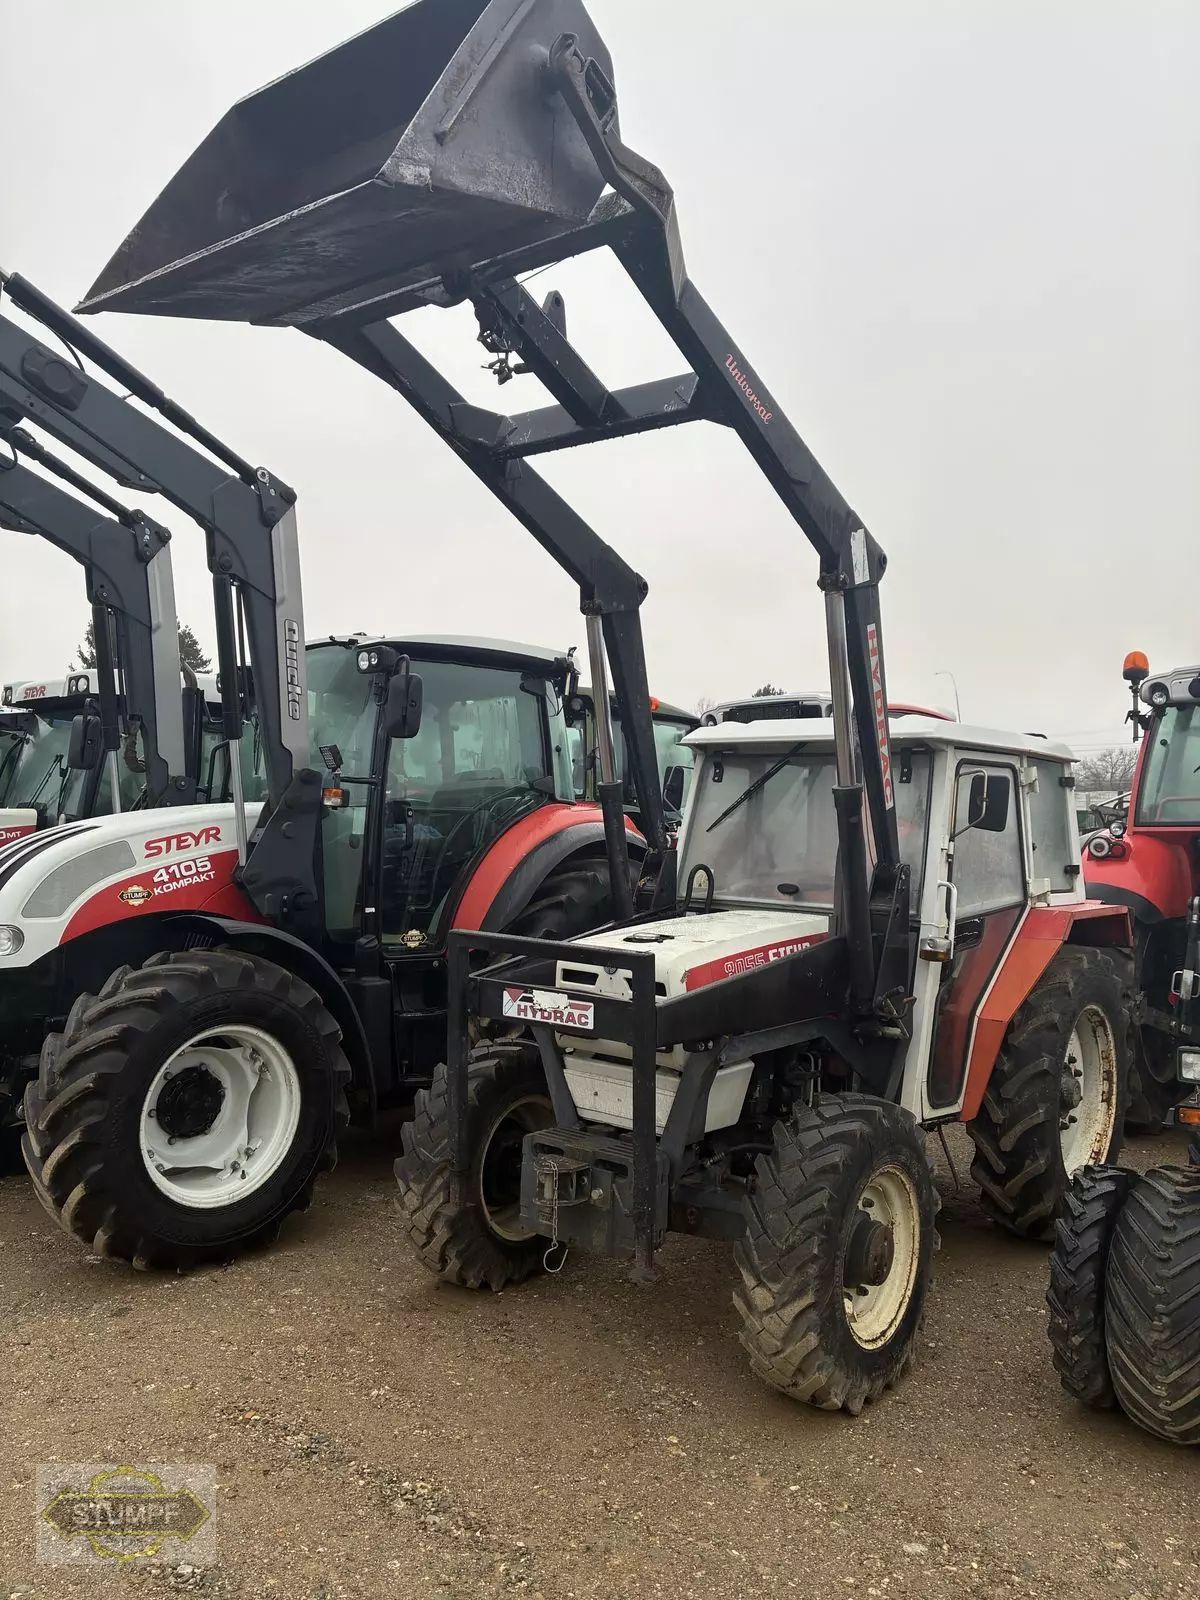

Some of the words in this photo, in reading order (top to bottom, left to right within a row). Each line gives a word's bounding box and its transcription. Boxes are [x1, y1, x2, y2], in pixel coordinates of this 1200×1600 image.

[725, 353, 773, 425] Universal
[23, 686, 47, 699] STEYR
[867, 629, 893, 804] HYDRAC
[144, 826, 222, 858] STEYR
[152, 857, 212, 883] 4105
[122, 891, 149, 900] STUMPF
[153, 871, 216, 896] KOMPAKT
[516, 1004, 589, 1026] HYDRAC
